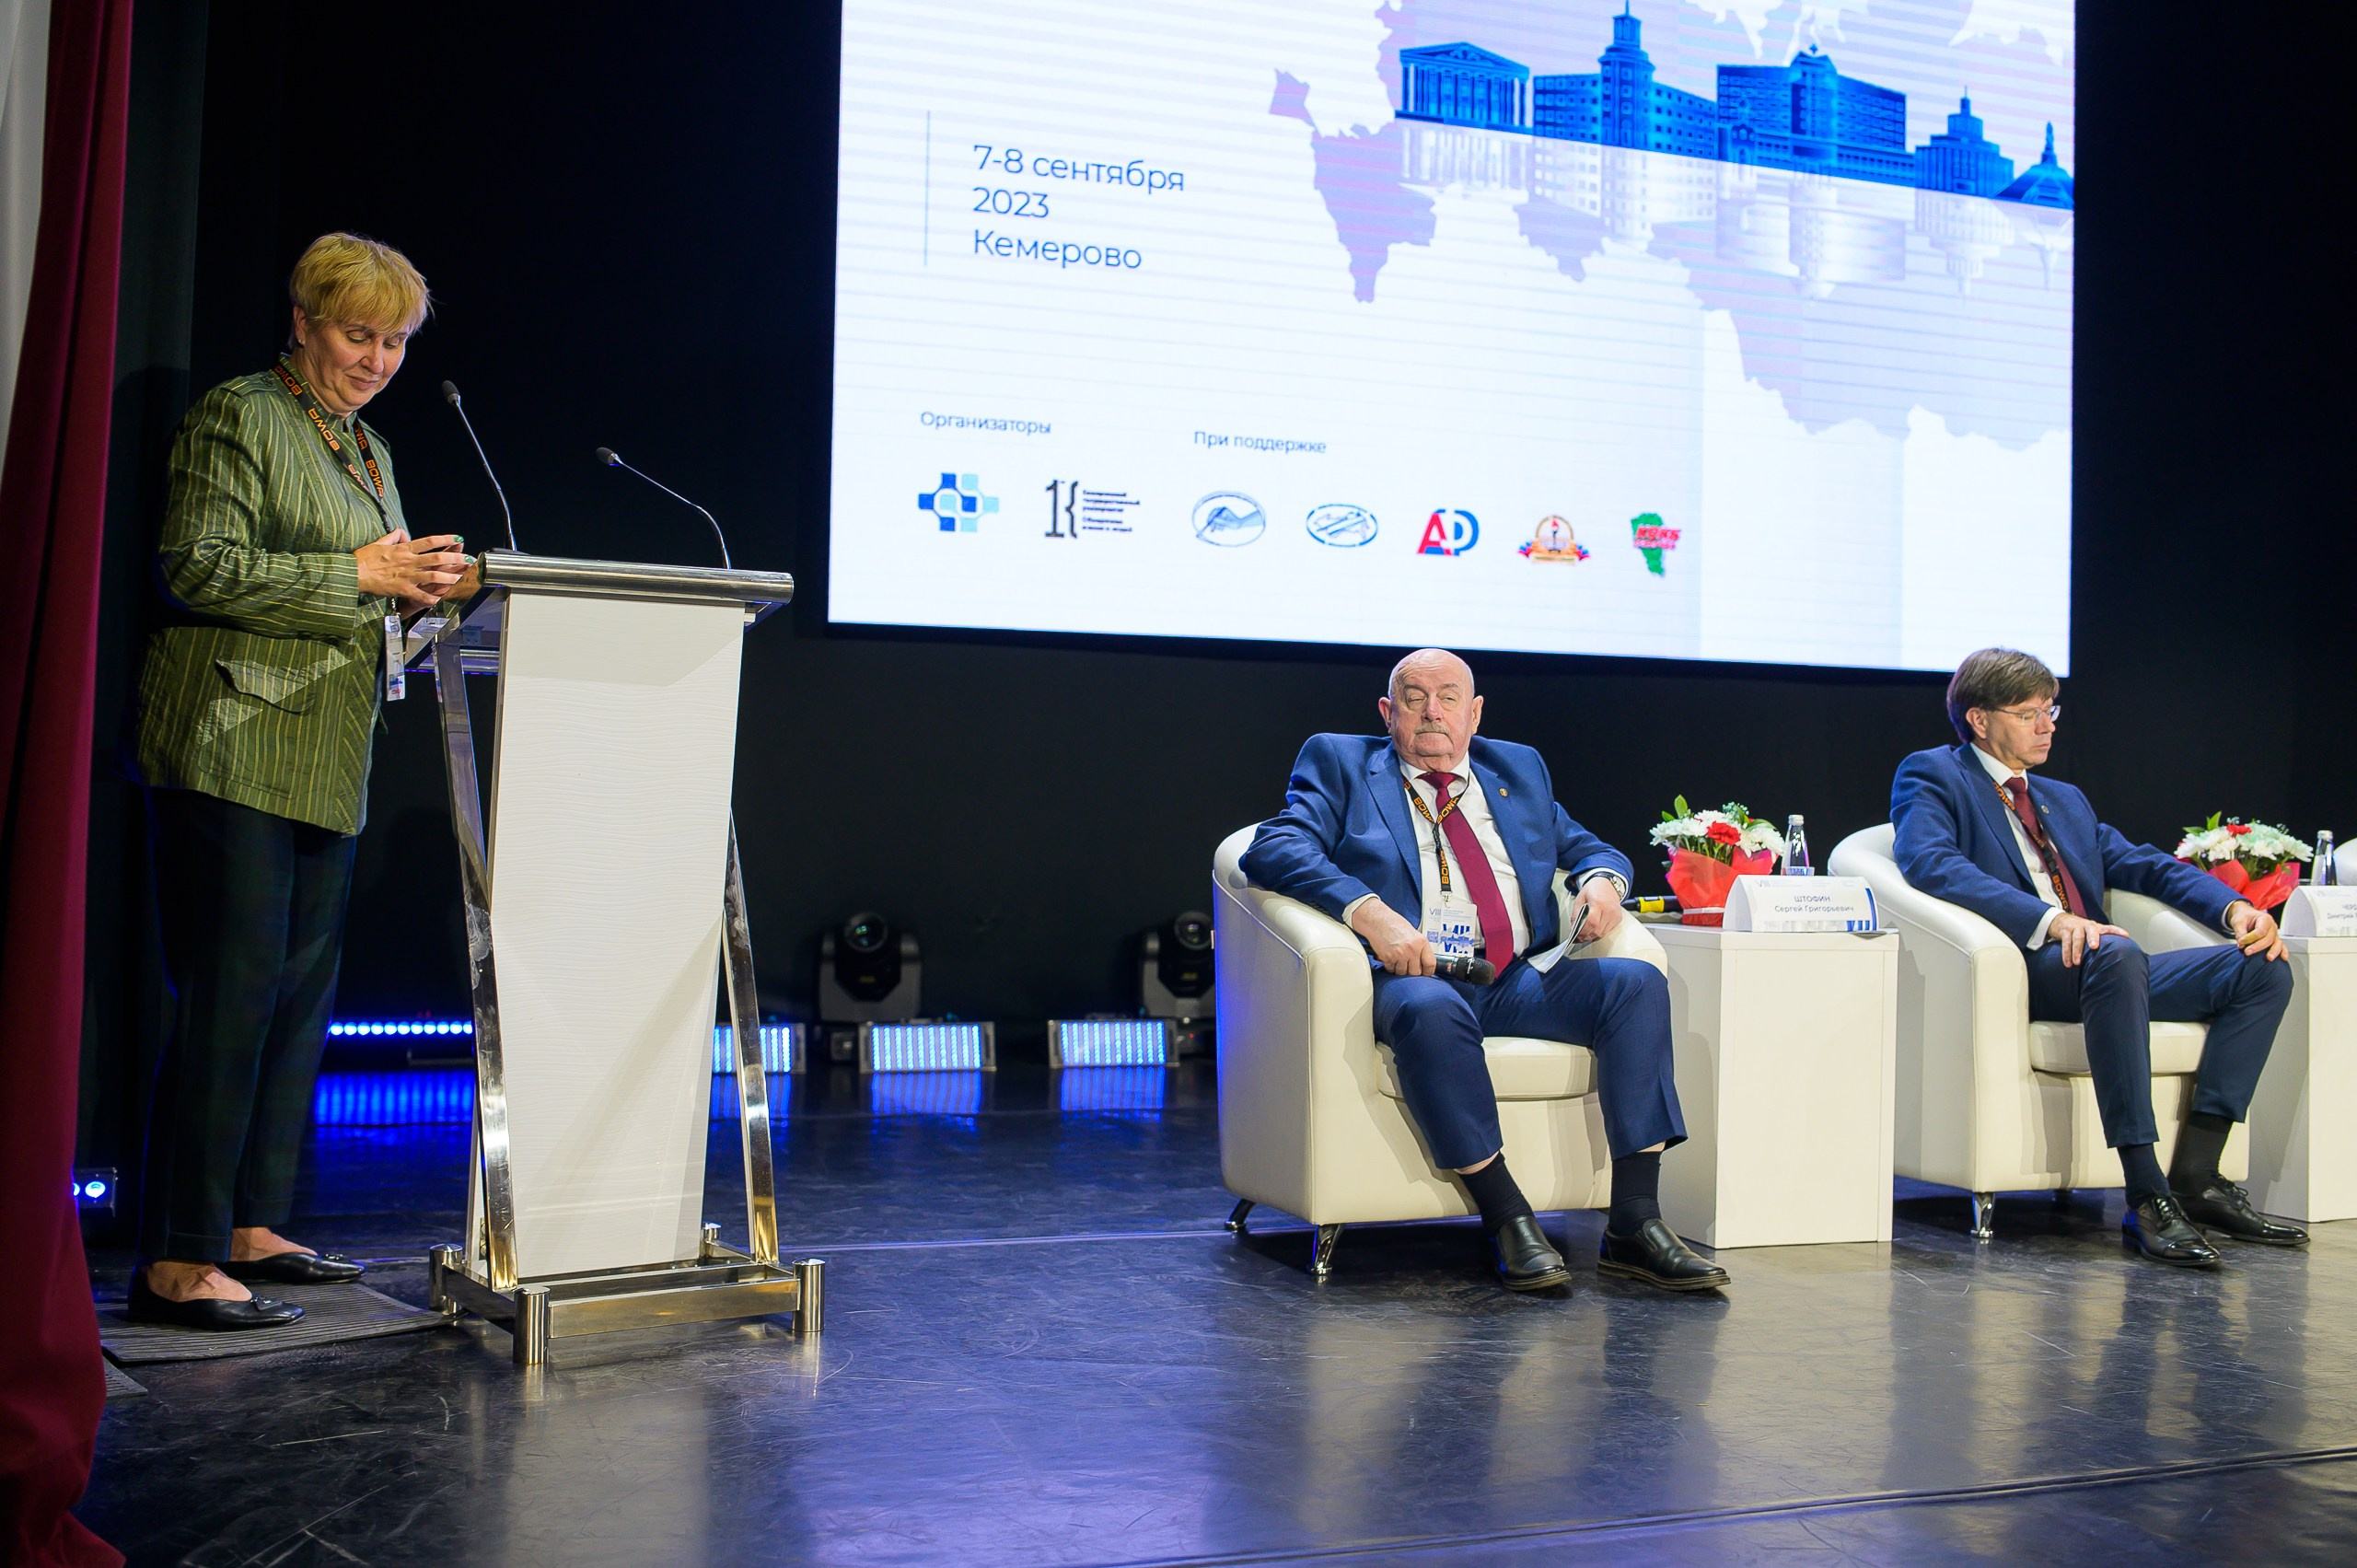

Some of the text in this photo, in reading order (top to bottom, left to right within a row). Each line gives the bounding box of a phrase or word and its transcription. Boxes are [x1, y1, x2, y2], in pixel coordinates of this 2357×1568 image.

[973, 145, 1185, 194] 7-8 сентября
[972, 187, 1050, 218] 2023
[973, 229, 1142, 268] Кемерово
[921, 411, 1051, 436] Организаторы
[1194, 431, 1327, 454] При поддержке
[1794, 895, 1831, 903] ШТОФИН
[2052, 874, 2069, 910] BOWA
[1774, 905, 1854, 914] Сергей Григорьевич
